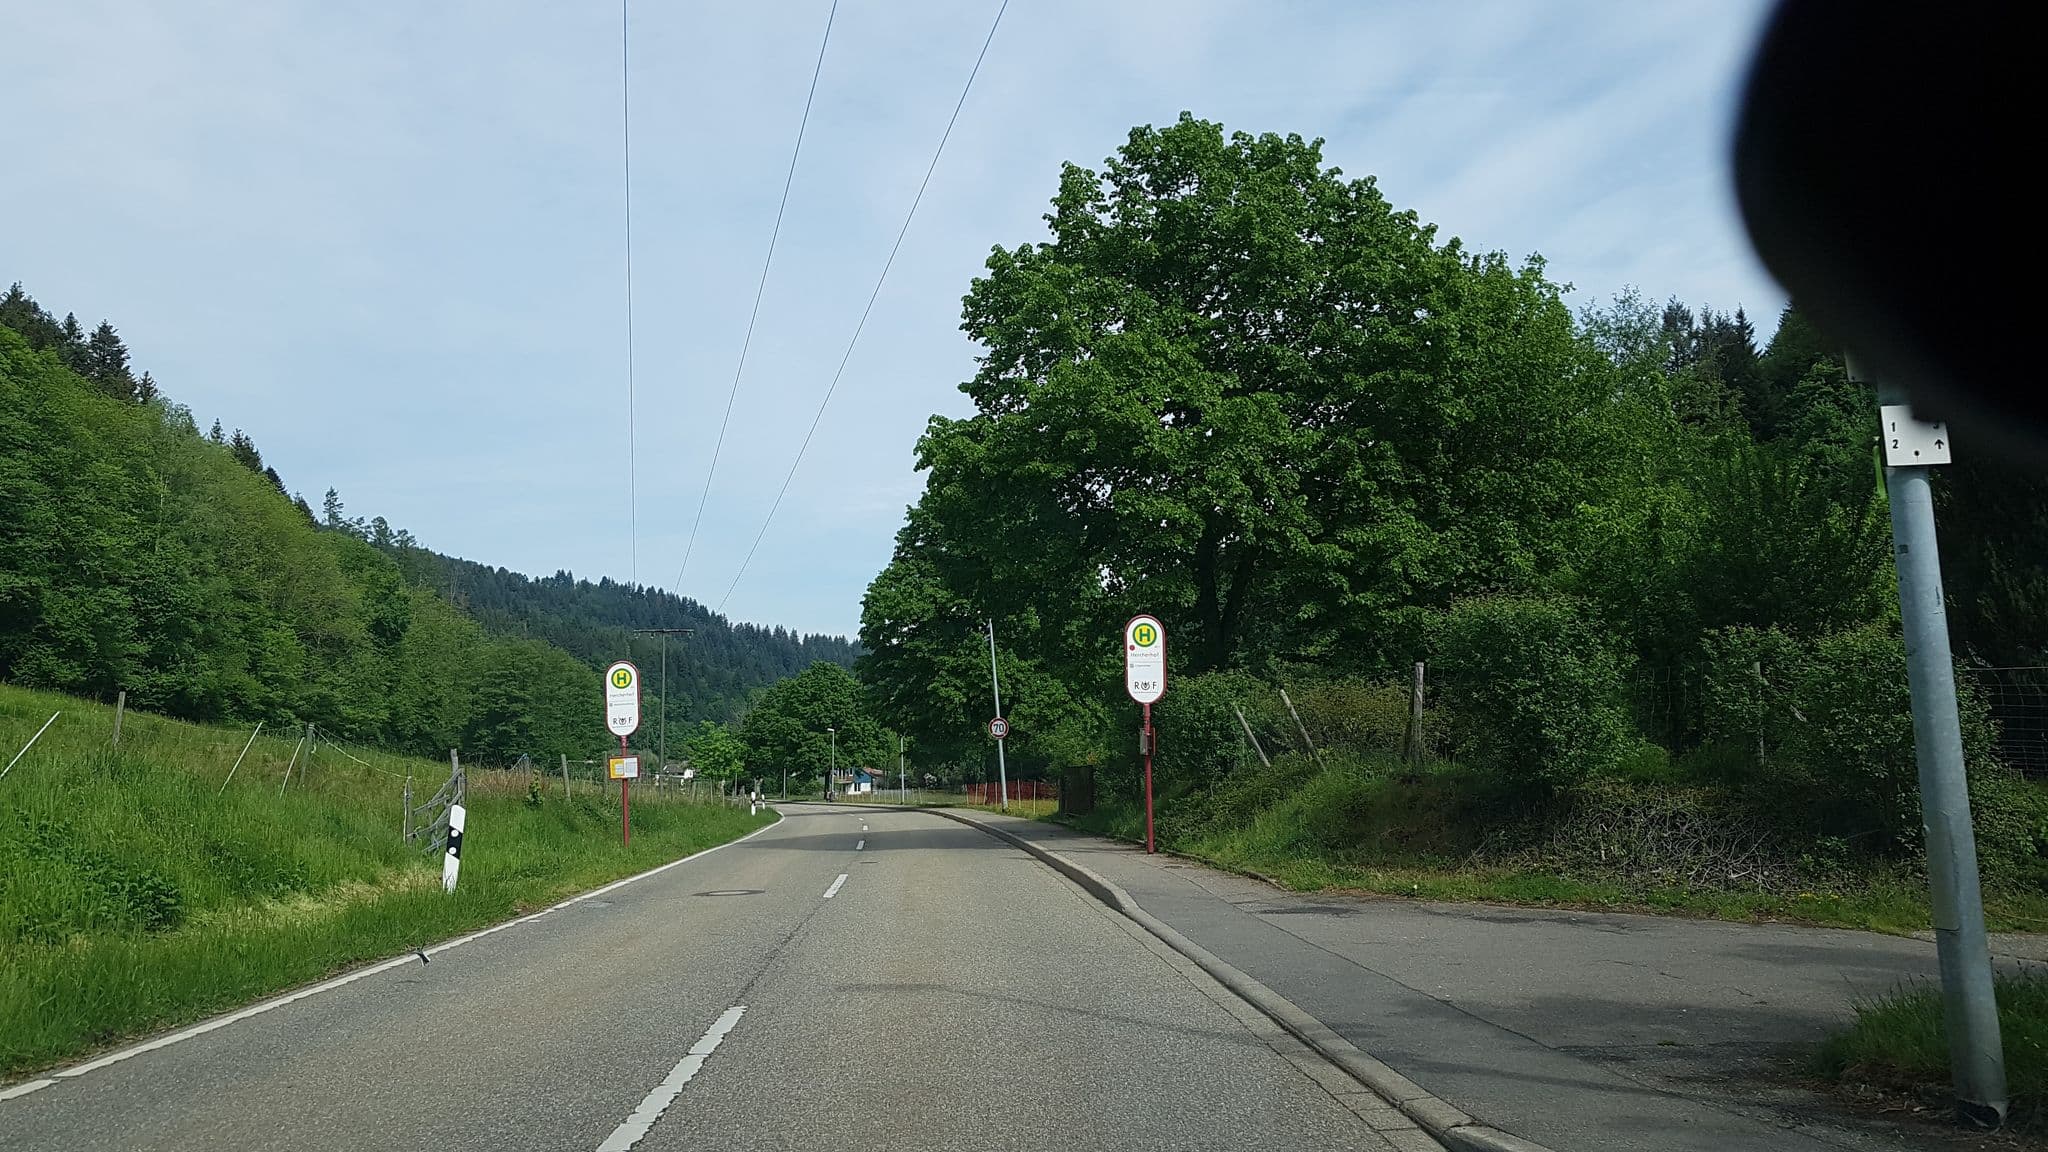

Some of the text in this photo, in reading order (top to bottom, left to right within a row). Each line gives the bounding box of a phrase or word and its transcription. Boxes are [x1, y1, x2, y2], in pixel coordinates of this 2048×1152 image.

[1891, 422, 1896, 432] 1
[1892, 439, 1899, 449] 2
[1139, 628, 1151, 642] H
[616, 672, 627, 685] H
[993, 723, 1005, 733] 70
